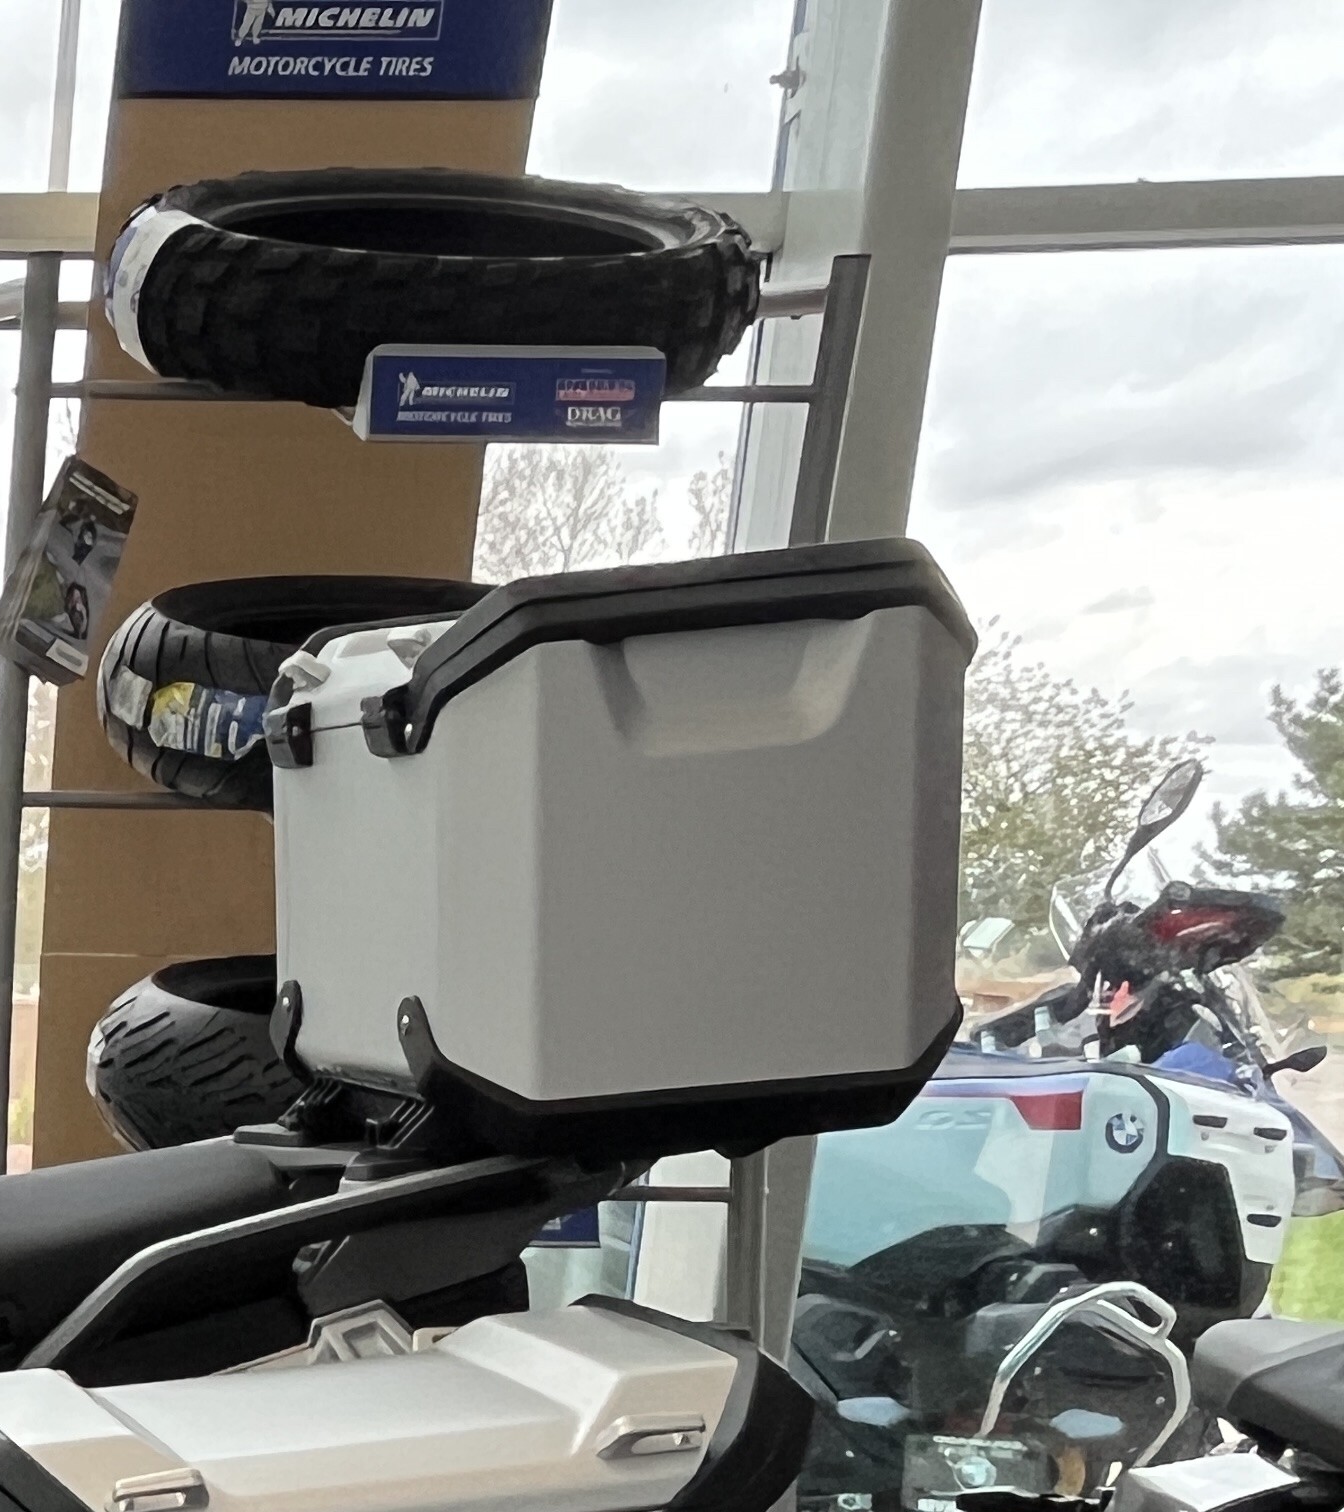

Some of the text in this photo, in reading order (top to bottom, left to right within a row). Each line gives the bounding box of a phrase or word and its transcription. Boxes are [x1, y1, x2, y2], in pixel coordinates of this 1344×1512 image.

[275, 7, 435, 28] MICHELIN
[228, 55, 435, 77] MOTORCYCLE TIRES
